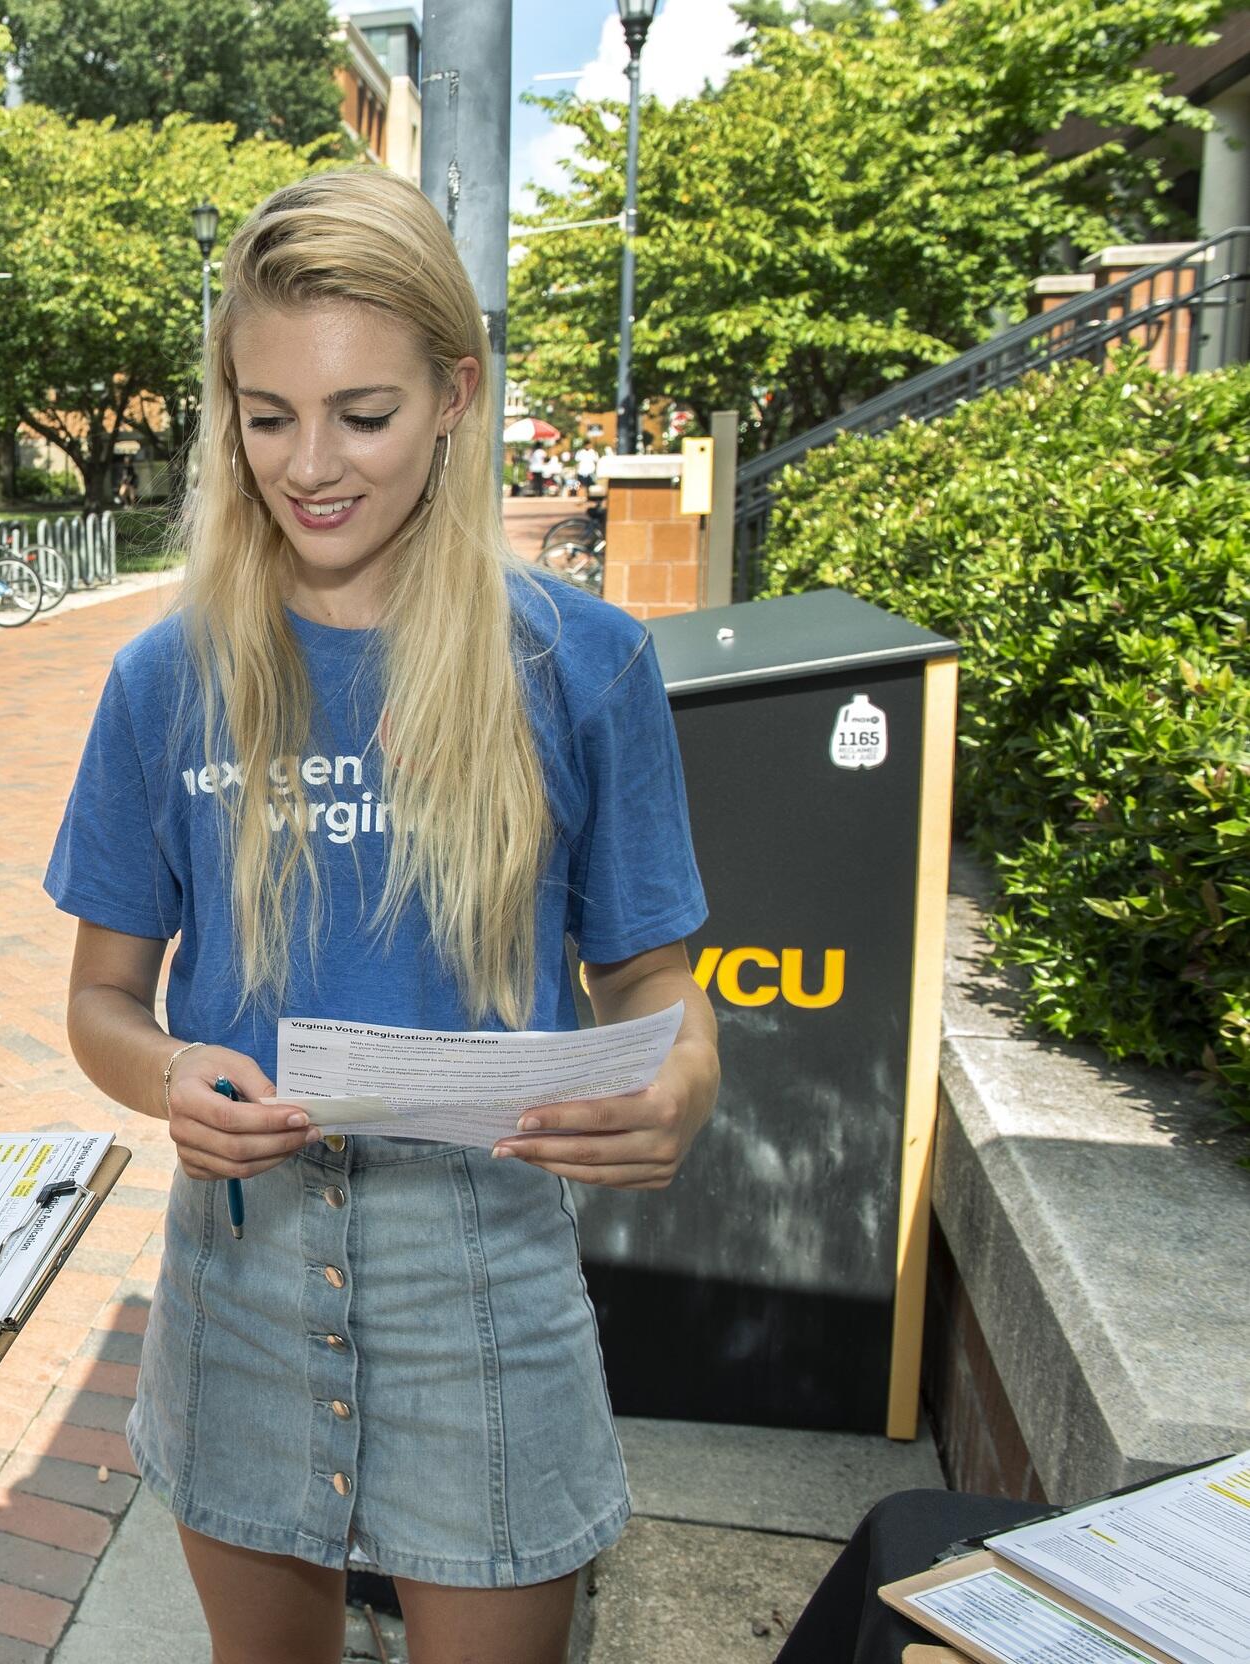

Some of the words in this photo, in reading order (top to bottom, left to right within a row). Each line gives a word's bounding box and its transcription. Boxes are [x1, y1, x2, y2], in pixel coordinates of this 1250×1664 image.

[839, 732, 880, 746] 1165
[269, 755, 362, 795] gen
[291, 1021, 333, 1032] Virginia
[334, 1025, 365, 1035] Voter
[367, 1029, 433, 1042] Registration
[436, 1035, 499, 1045] Application
[305, 1090, 332, 1098] Address
[76, 1137, 99, 1159] Virginia
[66, 1160, 85, 1176] Voter
[19, 1215, 50, 1250] Application
